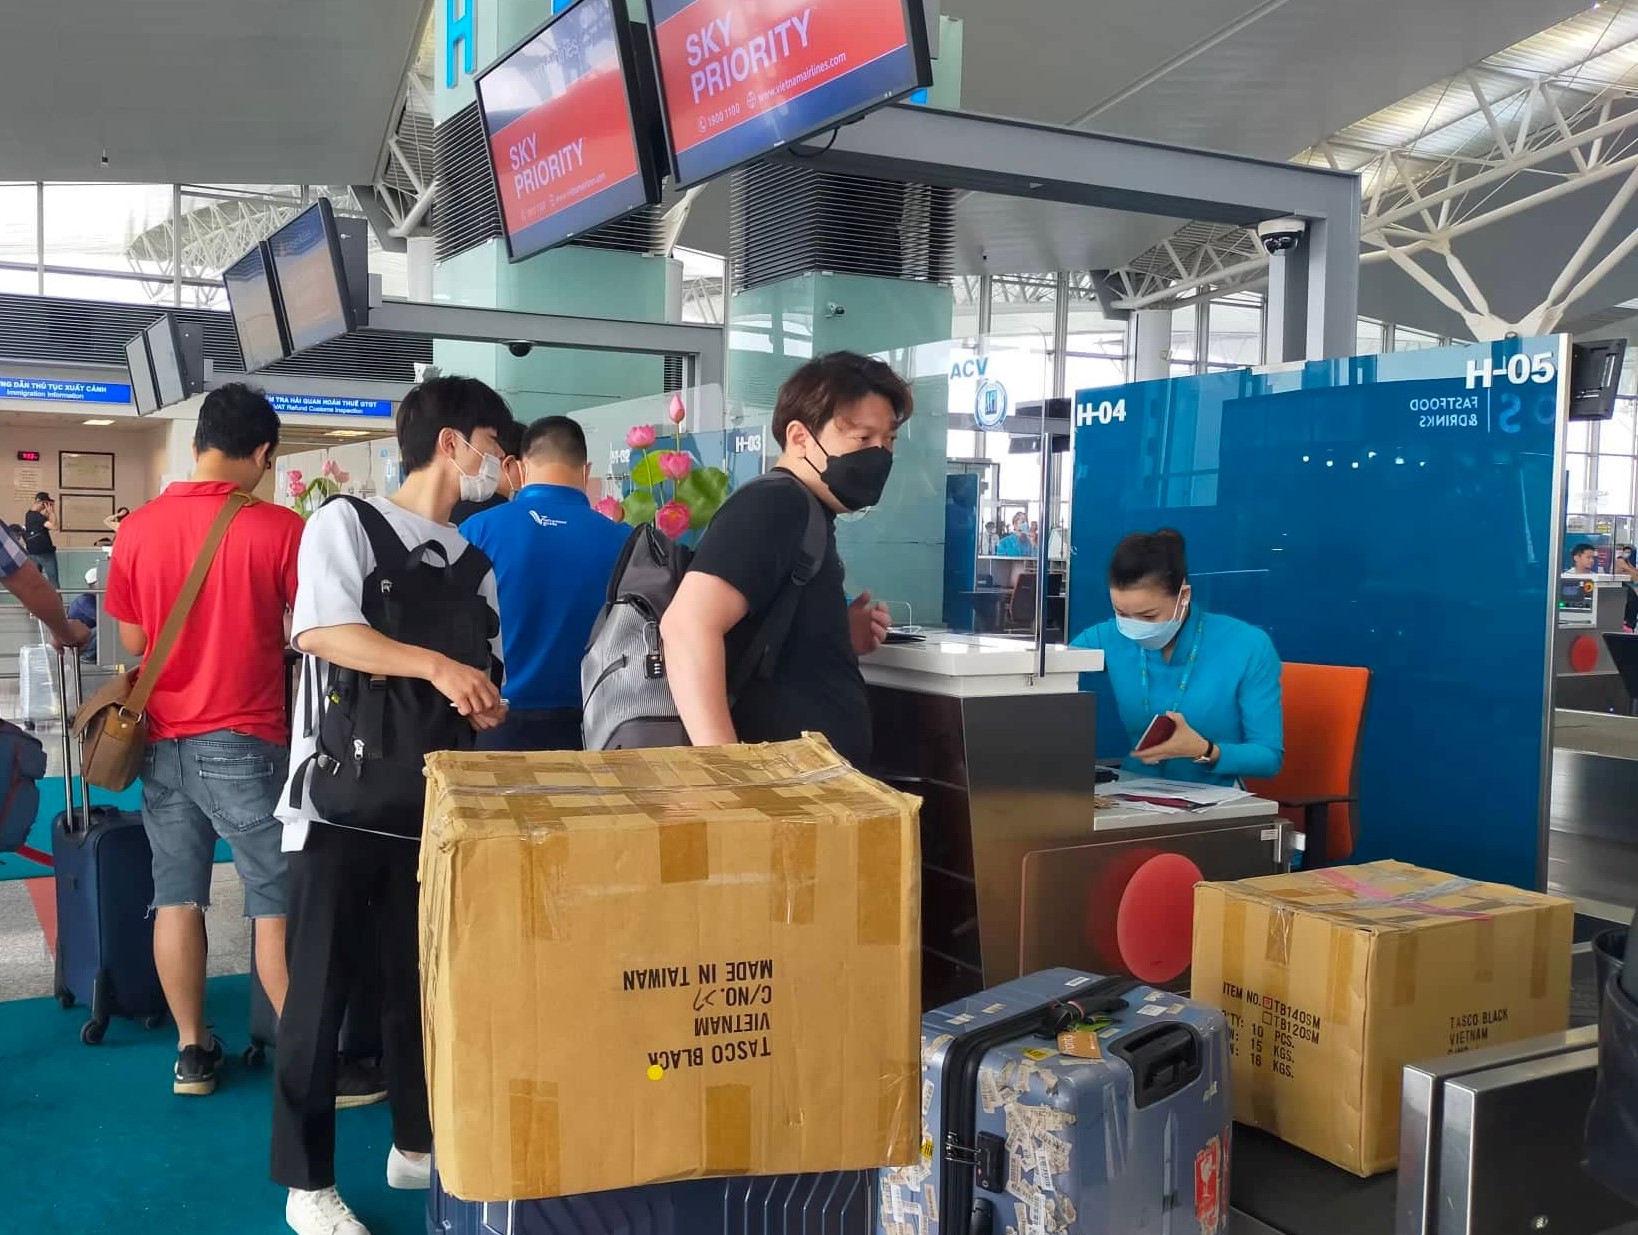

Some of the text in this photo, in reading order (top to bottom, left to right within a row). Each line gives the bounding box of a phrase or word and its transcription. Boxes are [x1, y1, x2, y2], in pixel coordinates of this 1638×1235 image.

[686, 10, 732, 66] SKY
[691, 8, 811, 104] PRIORITY
[757, 51, 847, 102] www.vietnamairlines.com
[707, 103, 741, 128] 1900 1100
[509, 132, 537, 171] SKY
[514, 137, 584, 199] PRIORITY
[950, 357, 988, 379] ACV
[1466, 352, 1554, 389] H-05
[6, 389, 46, 398] Immigration
[48, 383, 63, 392] TỤC
[1076, 399, 1126, 426] H-04
[736, 435, 761, 453] H-03
[623, 958, 773, 991] MADE IN TAIWAN
[720, 983, 772, 1007] C/NO.
[1222, 981, 1321, 1029] ITEM NO. TB140SM
[694, 1012, 771, 1037] VIETNAM
[1273, 1015, 1320, 1045] TB120SM
[1450, 1008, 1509, 1030] TASCO BLACK
[1251, 1024, 1264, 1038] 10
[1274, 1030, 1295, 1049] PCS.
[1449, 1027, 1488, 1046] VIETNAM
[711, 1036, 772, 1064] TASCO
[1250, 1038, 1263, 1053] 15
[1273, 1044, 1295, 1064] KGS.
[1272, 1059, 1295, 1079] KGS.
